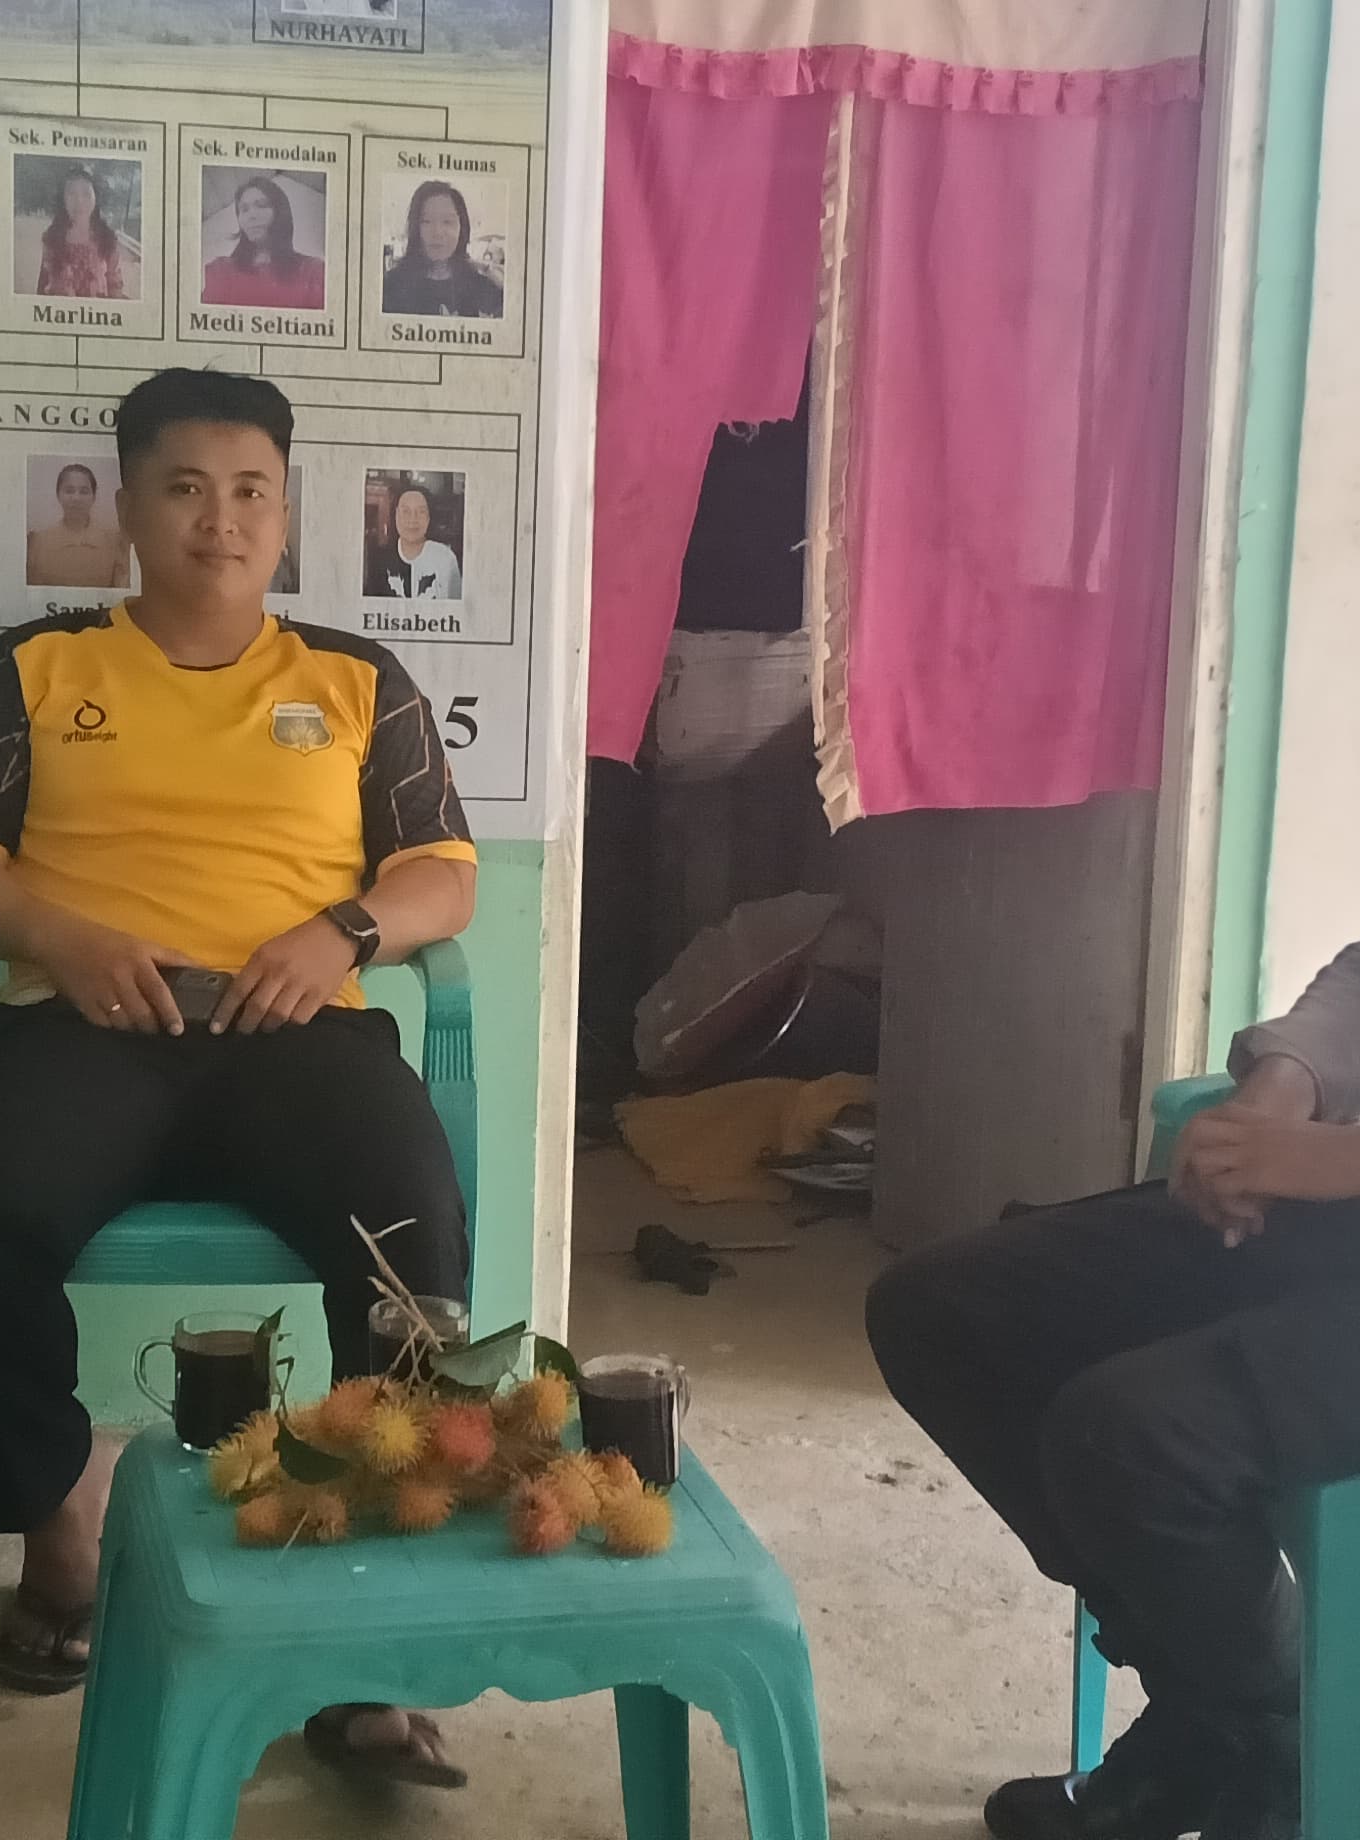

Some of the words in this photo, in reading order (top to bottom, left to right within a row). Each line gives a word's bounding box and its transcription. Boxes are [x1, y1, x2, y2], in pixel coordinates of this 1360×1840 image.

[270, 20, 409, 47] NURHAYATI
[8, 127, 45, 146] Sek.
[51, 130, 148, 152] Pemasaran
[192, 138, 229, 157] Sek.
[234, 140, 338, 164] Permodalan
[396, 150, 433, 170] Sek.
[438, 153, 497, 173] Humas
[32, 305, 124, 328] Marlina
[189, 312, 244, 333] Medi
[250, 314, 335, 338] Seltiani
[391, 322, 493, 347] Salomina
[362, 612, 461, 635] Elisabeth
[445, 696, 479, 749] 5
